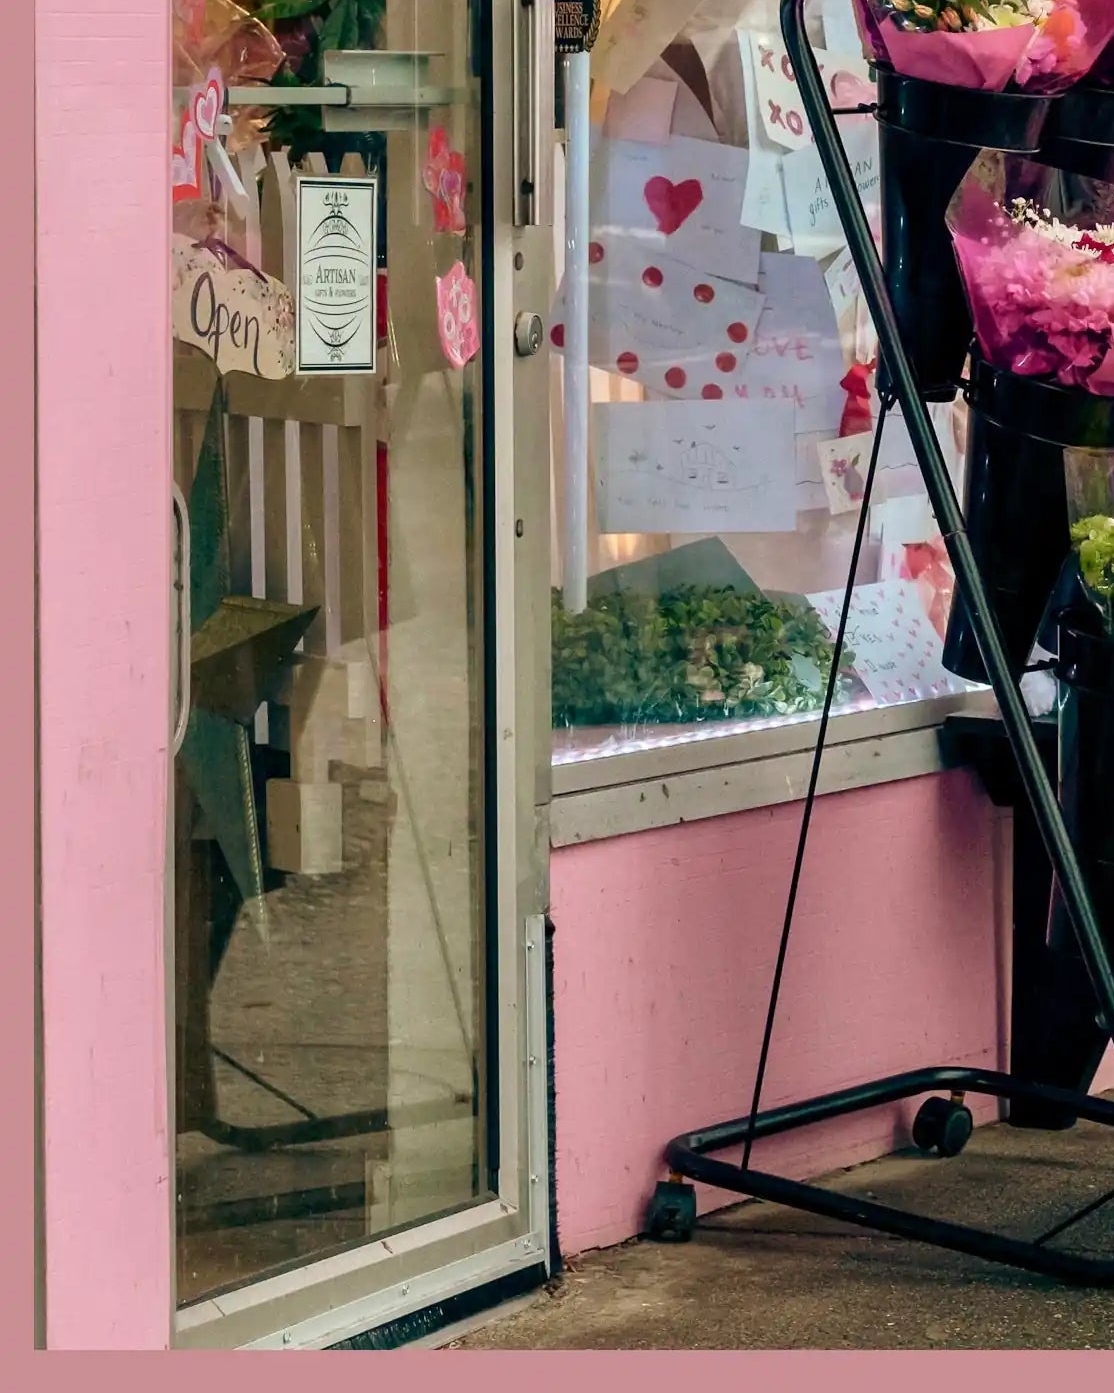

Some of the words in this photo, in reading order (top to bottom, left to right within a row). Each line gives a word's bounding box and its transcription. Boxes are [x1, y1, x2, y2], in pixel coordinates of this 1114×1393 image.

[555, 2, 583, 14] USINESS
[555, 14, 589, 26] ELLENCE
[555, 27, 583, 39] WARDS
[315, 263, 356, 284] ARTISAN
[190, 271, 263, 376] Open
